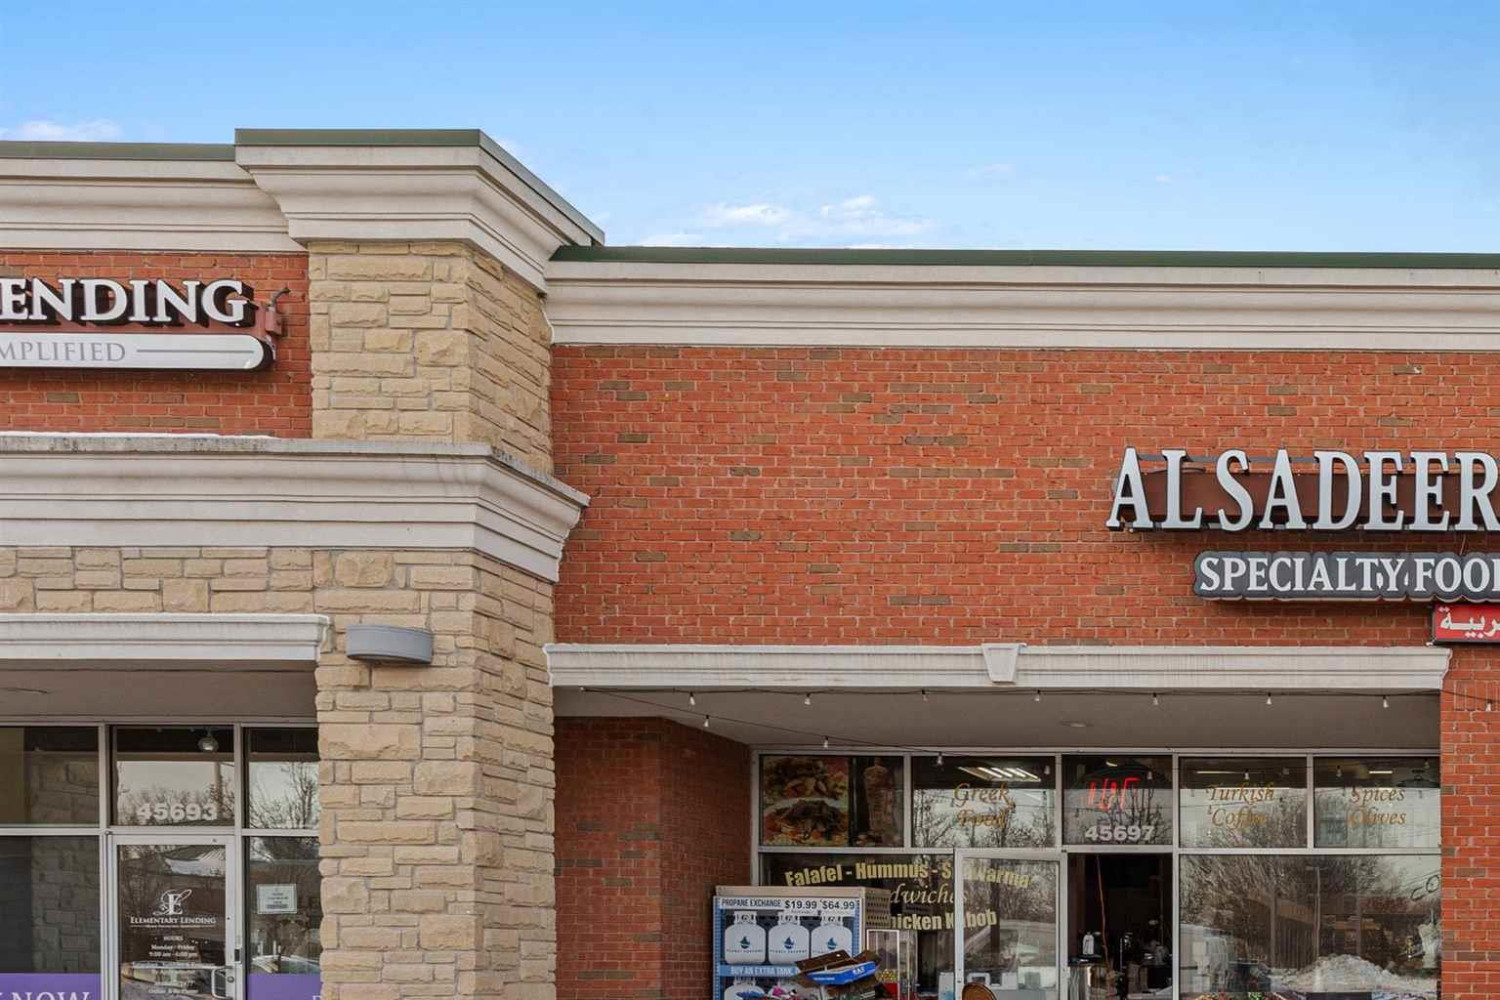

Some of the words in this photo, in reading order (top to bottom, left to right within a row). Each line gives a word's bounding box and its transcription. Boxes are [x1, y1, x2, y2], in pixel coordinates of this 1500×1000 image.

[1200, 556, 1404, 593] SPECIALTY
[953, 782, 1011, 808] Greek
[1207, 782, 1275, 806] Turkish
[1350, 784, 1405, 807] Spices
[136, 802, 218, 825] 45693
[1085, 825, 1155, 842] 45697
[784, 863, 843, 887] Falafel
[855, 861, 929, 880] Hummus
[721, 899, 749, 907] PROPANE
[784, 899, 818, 909] $19.99
[822, 900, 855, 910] $64.99
